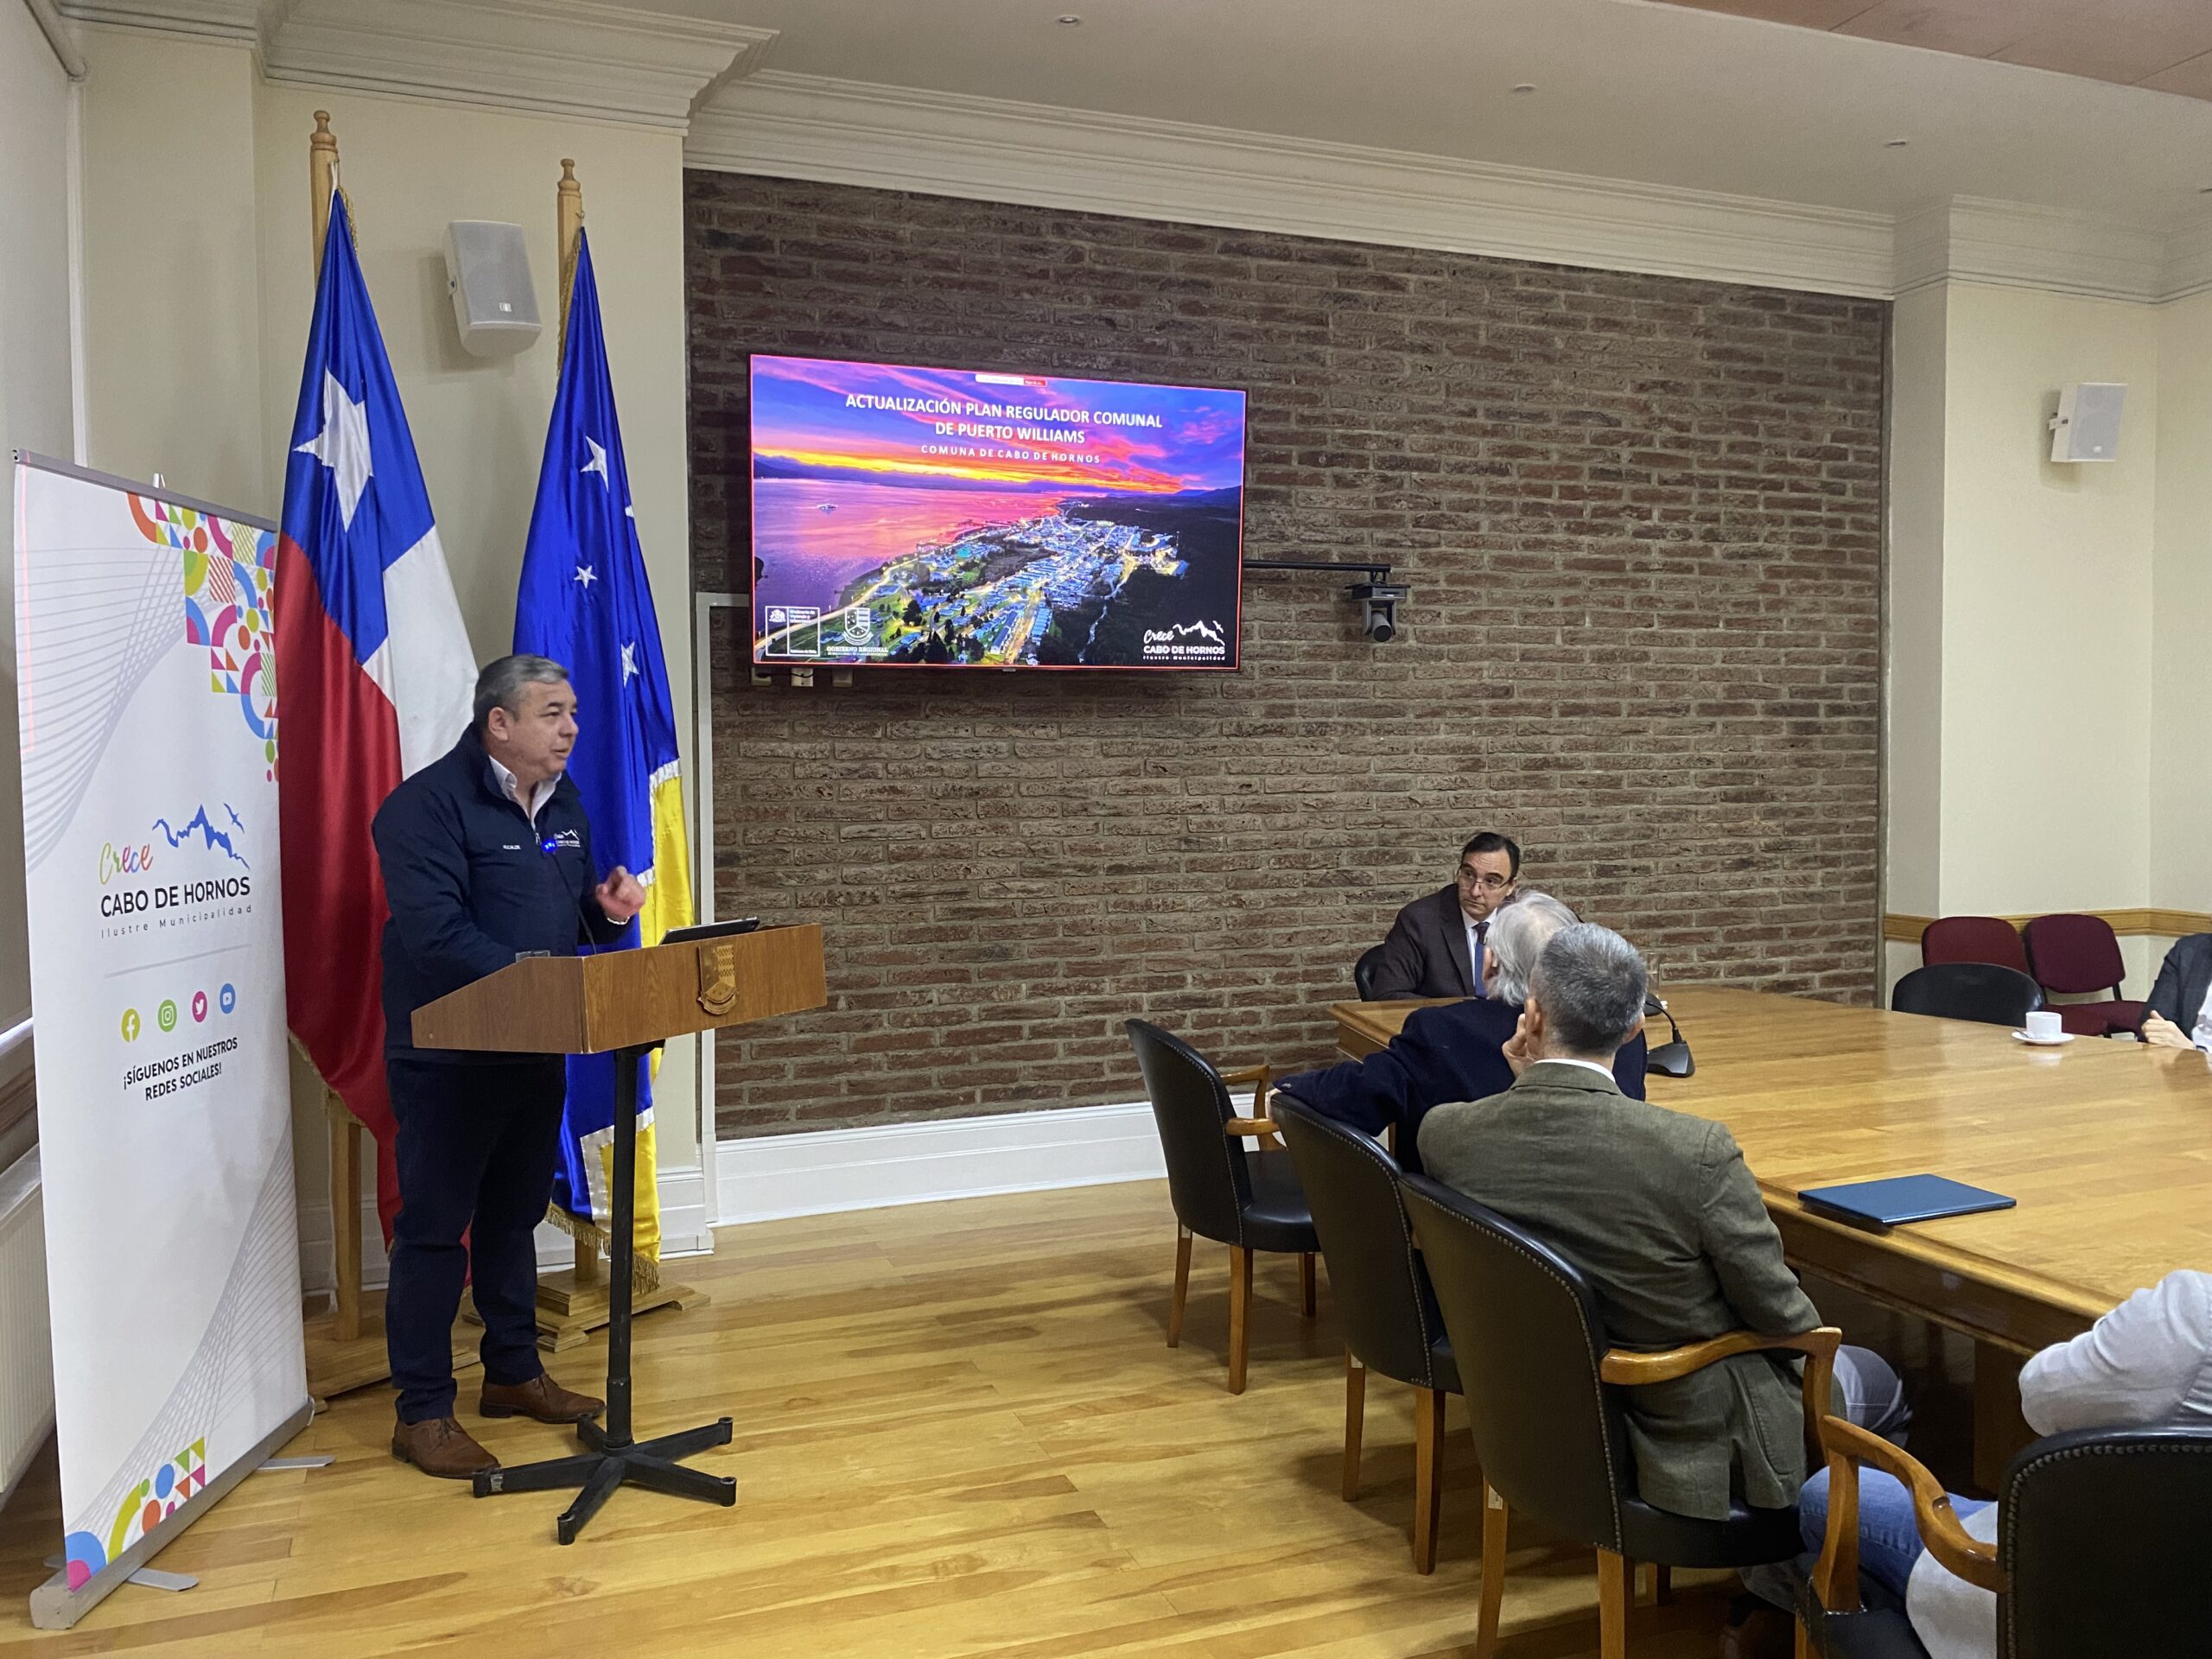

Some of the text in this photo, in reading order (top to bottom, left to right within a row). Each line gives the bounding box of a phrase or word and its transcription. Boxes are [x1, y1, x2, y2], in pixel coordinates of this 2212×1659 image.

[845, 394, 1163, 429] ACTUALIZACIÓN PLAN REGULADOR COMUNAL
[935, 422, 1085, 444] DE PUERTO WILLIAMS
[921, 445, 1100, 464] COMUNA DE CABO DE HORNOS
[1143, 629, 1175, 644] Crece
[1143, 645, 1225, 655] CABO DE HORNOS
[99, 842, 154, 886] Crece
[100, 876, 251, 918] CABO DE HORNOS
[101, 905, 252, 939] Ilustre Municipalidad
[124, 1037, 238, 1090] ¡SÍGUENOS EN NUESTROS
[145, 1062, 222, 1101] REDES SOCIALES!
